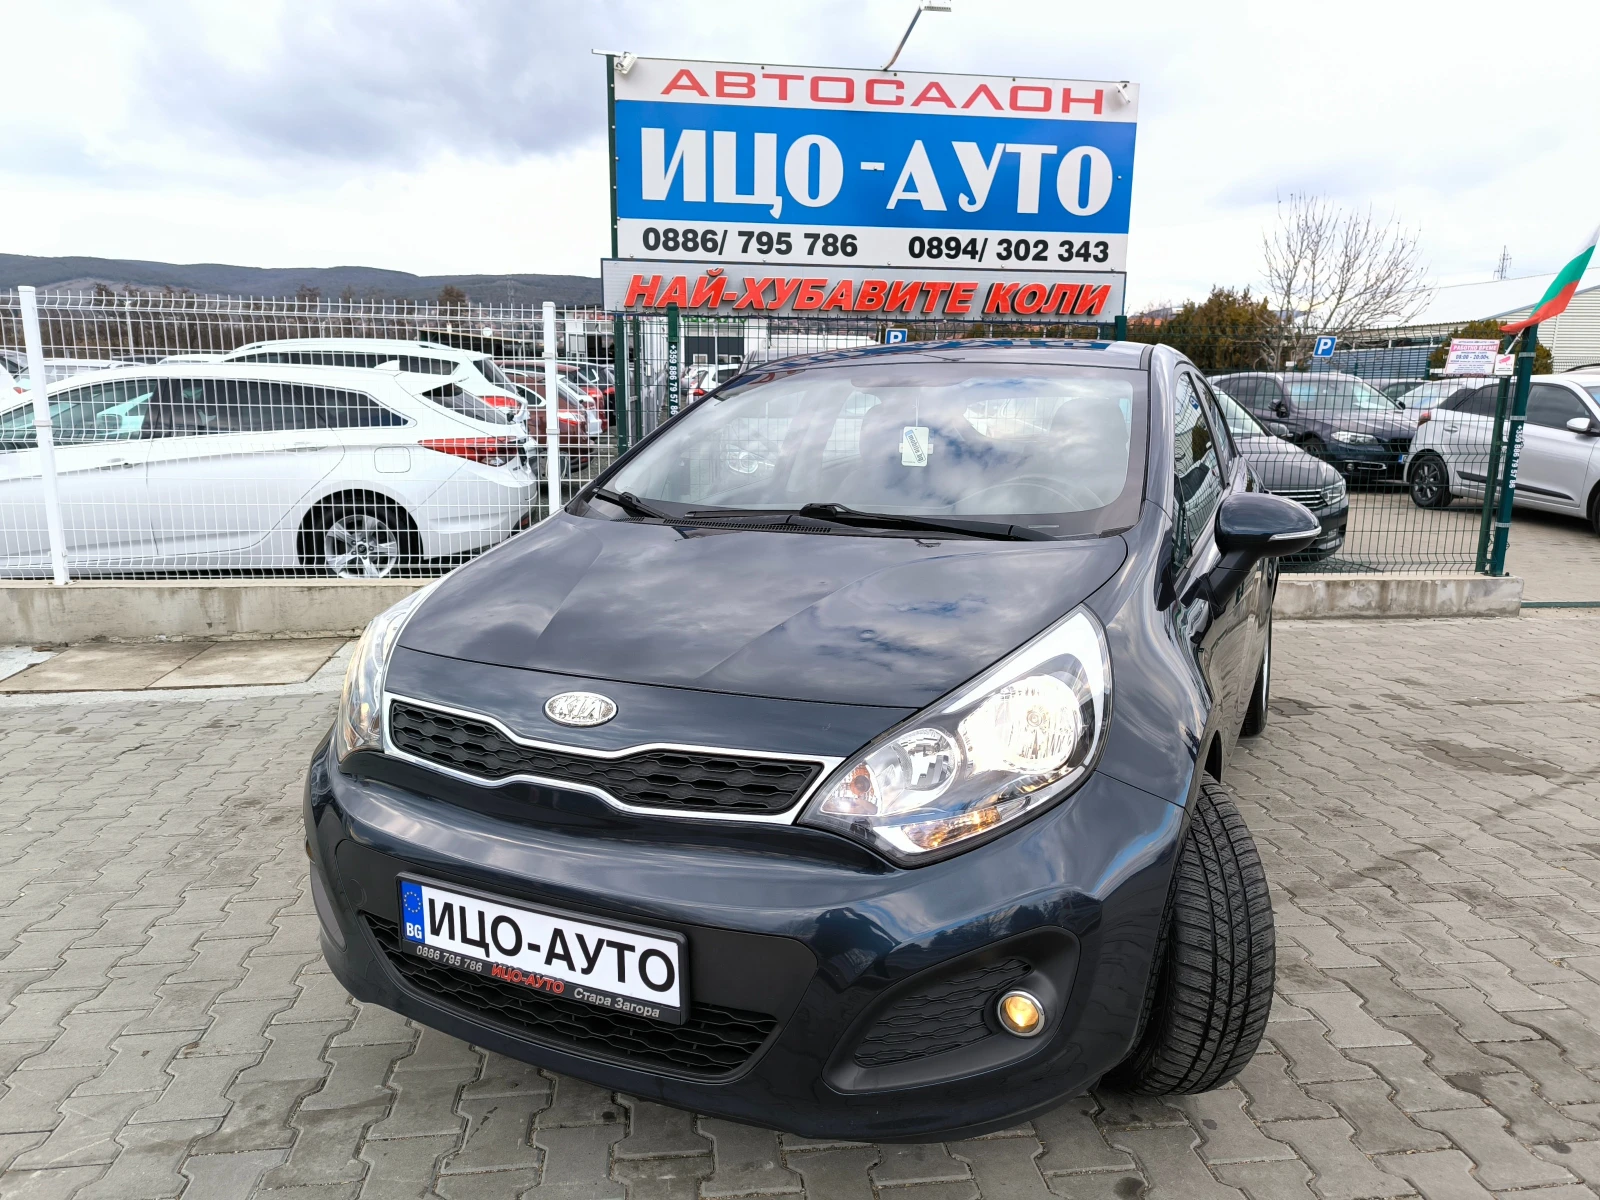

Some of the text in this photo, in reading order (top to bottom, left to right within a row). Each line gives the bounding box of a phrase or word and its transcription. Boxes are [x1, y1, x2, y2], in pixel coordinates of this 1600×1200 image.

[661, 69, 1103, 115] АВТОСАЛОН
[642, 227, 858, 257] 0886/ 795 786
[908, 236, 1109, 263] 0894/ 302 343
[623, 267, 1112, 315] НАЙ-ХУБАВИТЕ КОЛИ
[890, 331, 902, 343] P
[1318, 338, 1332, 354] P
[669, 344, 678, 415] +359 886 79 57 86
[1511, 459, 1519, 467] 79
[1513, 444, 1521, 457] 886
[1510, 469, 1518, 478] 57
[406, 922, 423, 940] BG
[428, 897, 676, 993] ИЦО-АУТО
[416, 945, 660, 1018] 0886 795 786 ИЦО-АУТО Стара Загора
